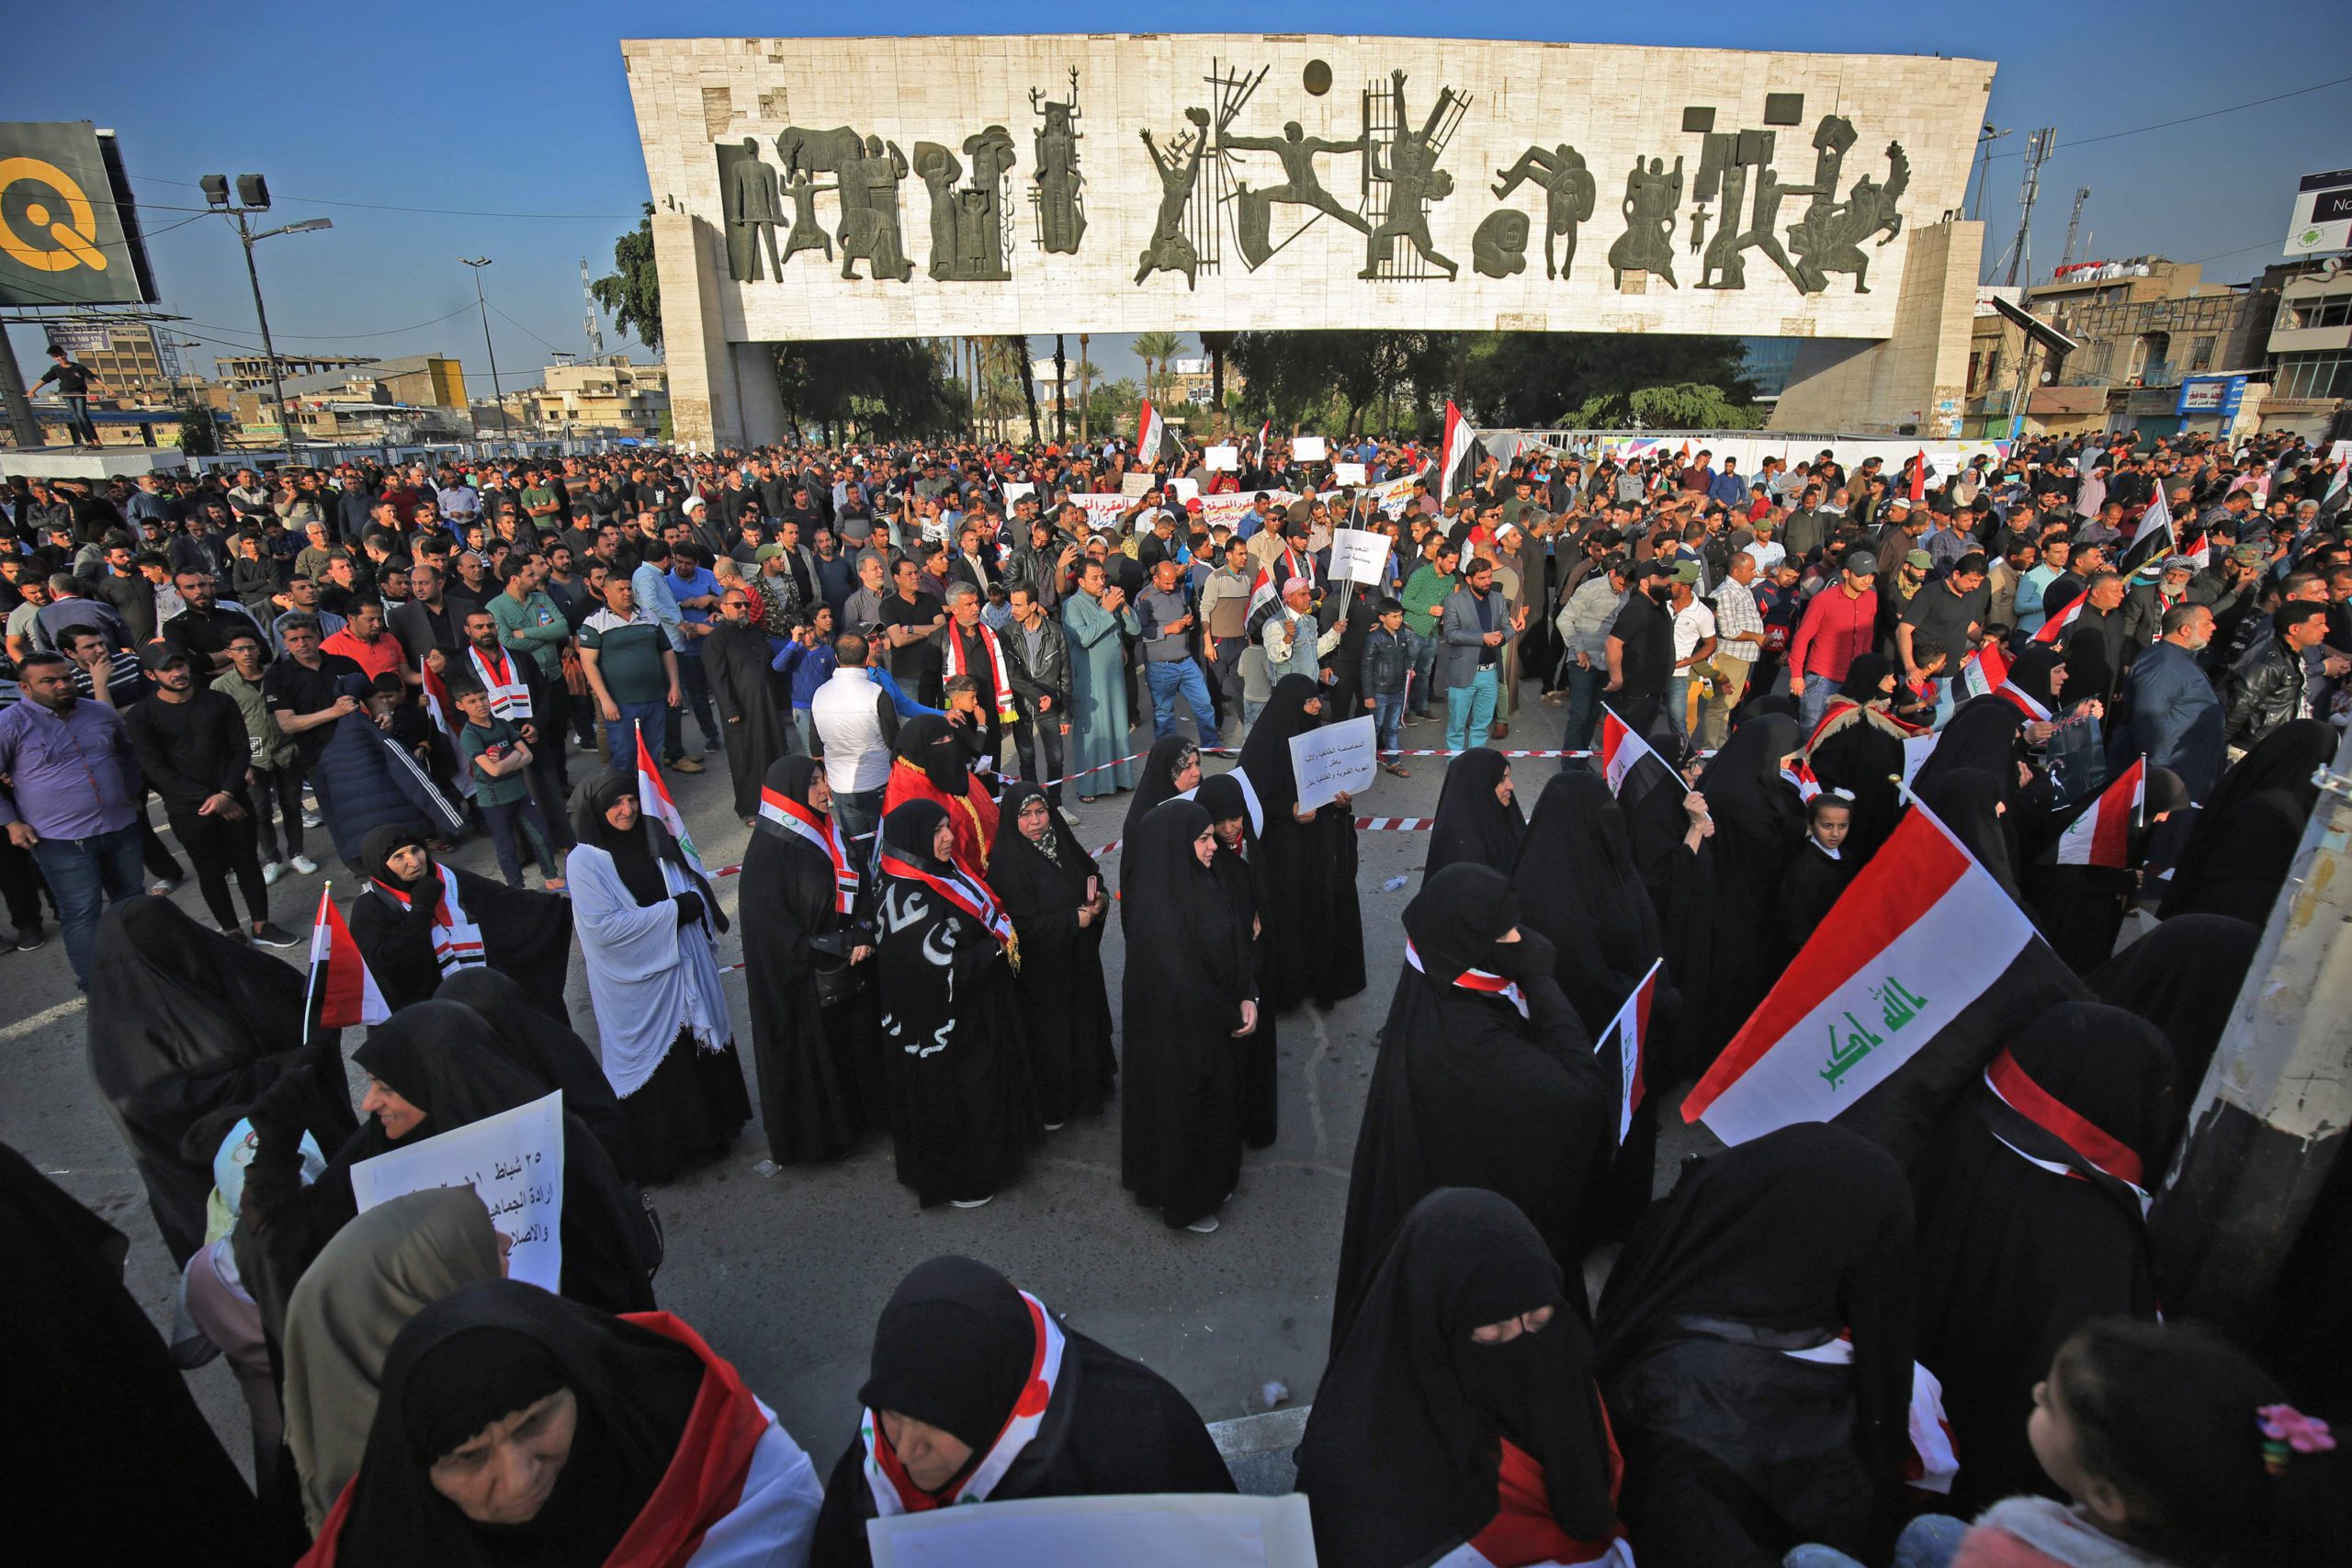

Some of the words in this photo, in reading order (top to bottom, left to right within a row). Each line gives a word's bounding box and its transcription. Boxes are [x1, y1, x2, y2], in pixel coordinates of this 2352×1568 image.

[1337, 740, 1365, 752] المحاصصة
[1868, 976, 1929, 1033] الله
[1818, 1011, 1884, 1092] اكبر
[494, 1155, 522, 1181] شباط
[524, 1151, 542, 1169] ٢٥
[488, 1191, 526, 1220] الجماهي
[529, 1182, 553, 1205] ارادة
